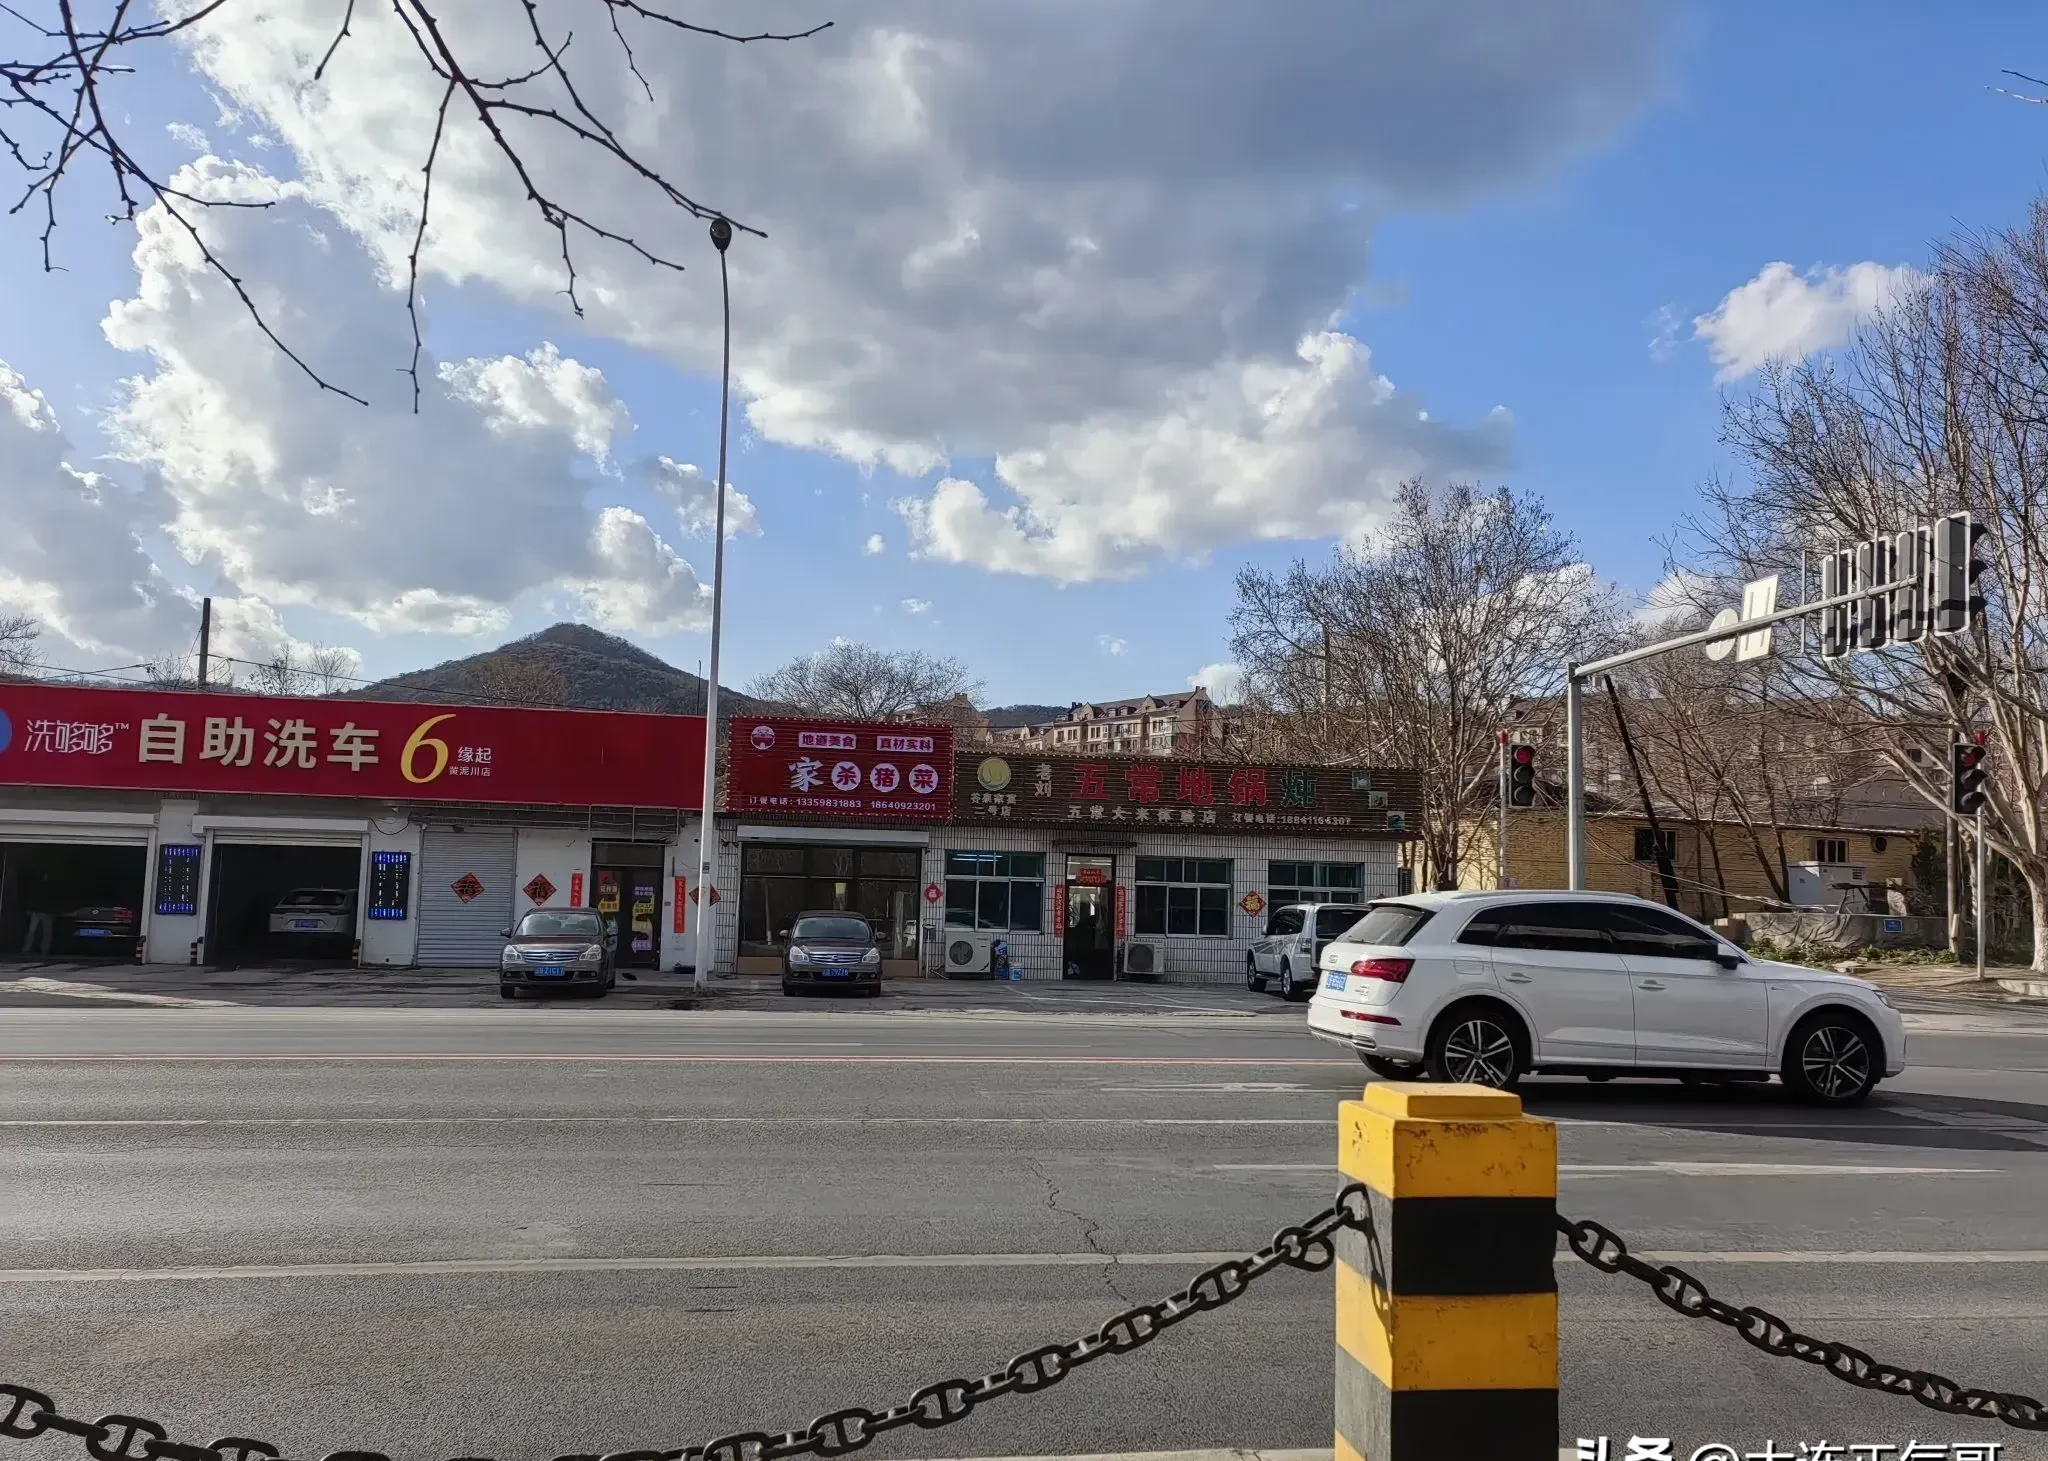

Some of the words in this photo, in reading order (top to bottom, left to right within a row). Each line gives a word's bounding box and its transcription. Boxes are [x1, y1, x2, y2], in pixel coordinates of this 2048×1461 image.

[138, 713, 380, 771] 自助洗车
[400, 713, 457, 784] 6
[802, 734, 855, 748] 地道美食
[879, 736, 932, 751] 真材实料
[457, 746, 492, 764] 缘起
[449, 766, 491, 777] 黄泥川店
[1070, 763, 1319, 809] 五常地锅炖
[871, 800, 937, 811] 18640923201
[974, 805, 1012, 817] 二号店
[1067, 805, 1217, 824] 五常大米体验店
